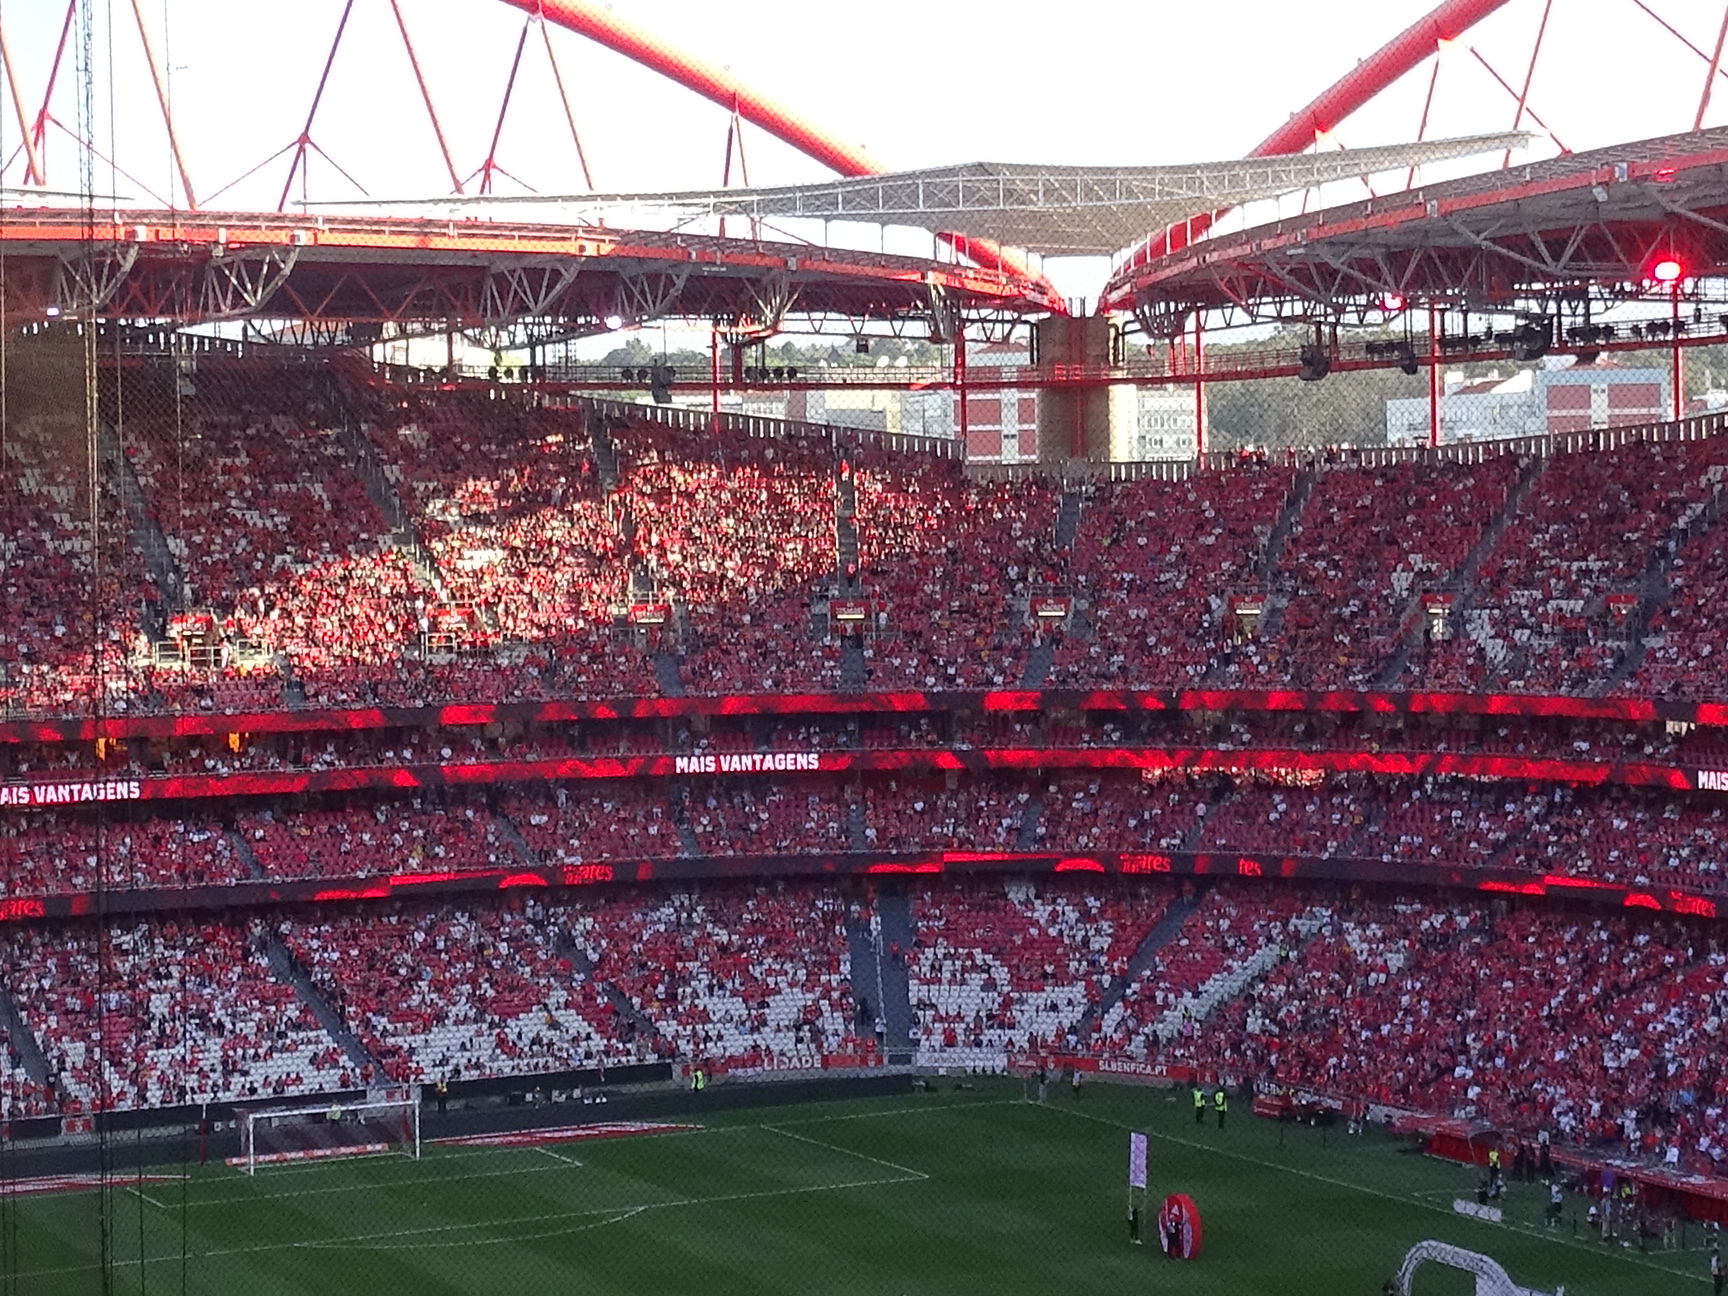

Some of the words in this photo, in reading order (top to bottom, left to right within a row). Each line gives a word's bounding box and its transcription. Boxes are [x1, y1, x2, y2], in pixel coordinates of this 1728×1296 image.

[675, 756, 716, 774] MAIS
[719, 753, 819, 772] VANTAGENS
[34, 782, 140, 804] VANTAGENS
